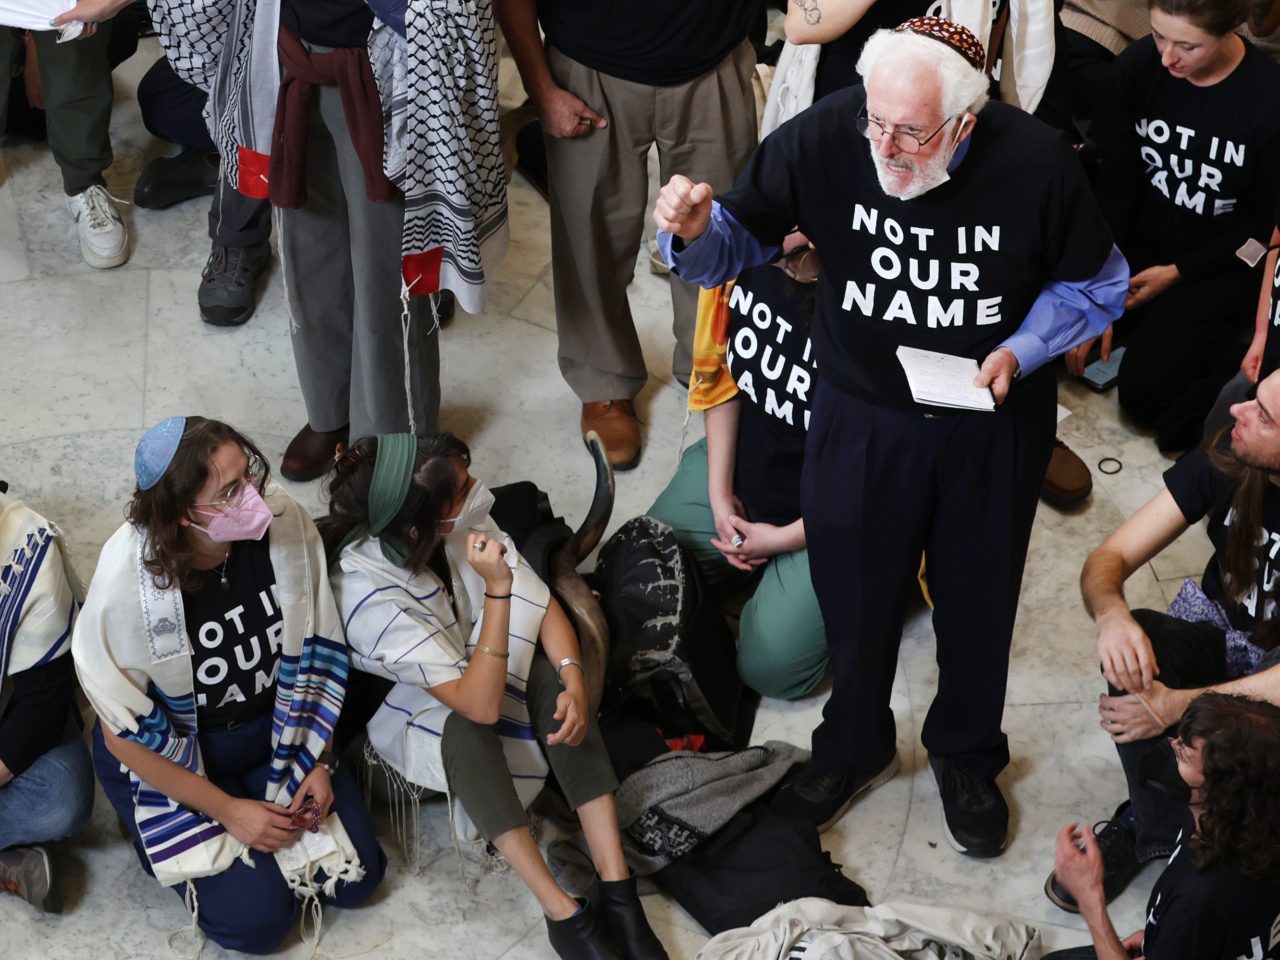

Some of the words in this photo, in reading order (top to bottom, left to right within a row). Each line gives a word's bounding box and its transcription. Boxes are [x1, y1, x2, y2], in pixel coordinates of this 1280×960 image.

[1141, 146, 1223, 192] OUR
[1210, 137, 1245, 167] IN
[852, 204, 934, 251] NOT
[957, 225, 1000, 254] IN
[871, 247, 979, 291] OUR
[729, 285, 792, 343] NOT
[842, 280, 1002, 328] NAME
[734, 326, 811, 402] OUR
[199, 604, 245, 649] OT
